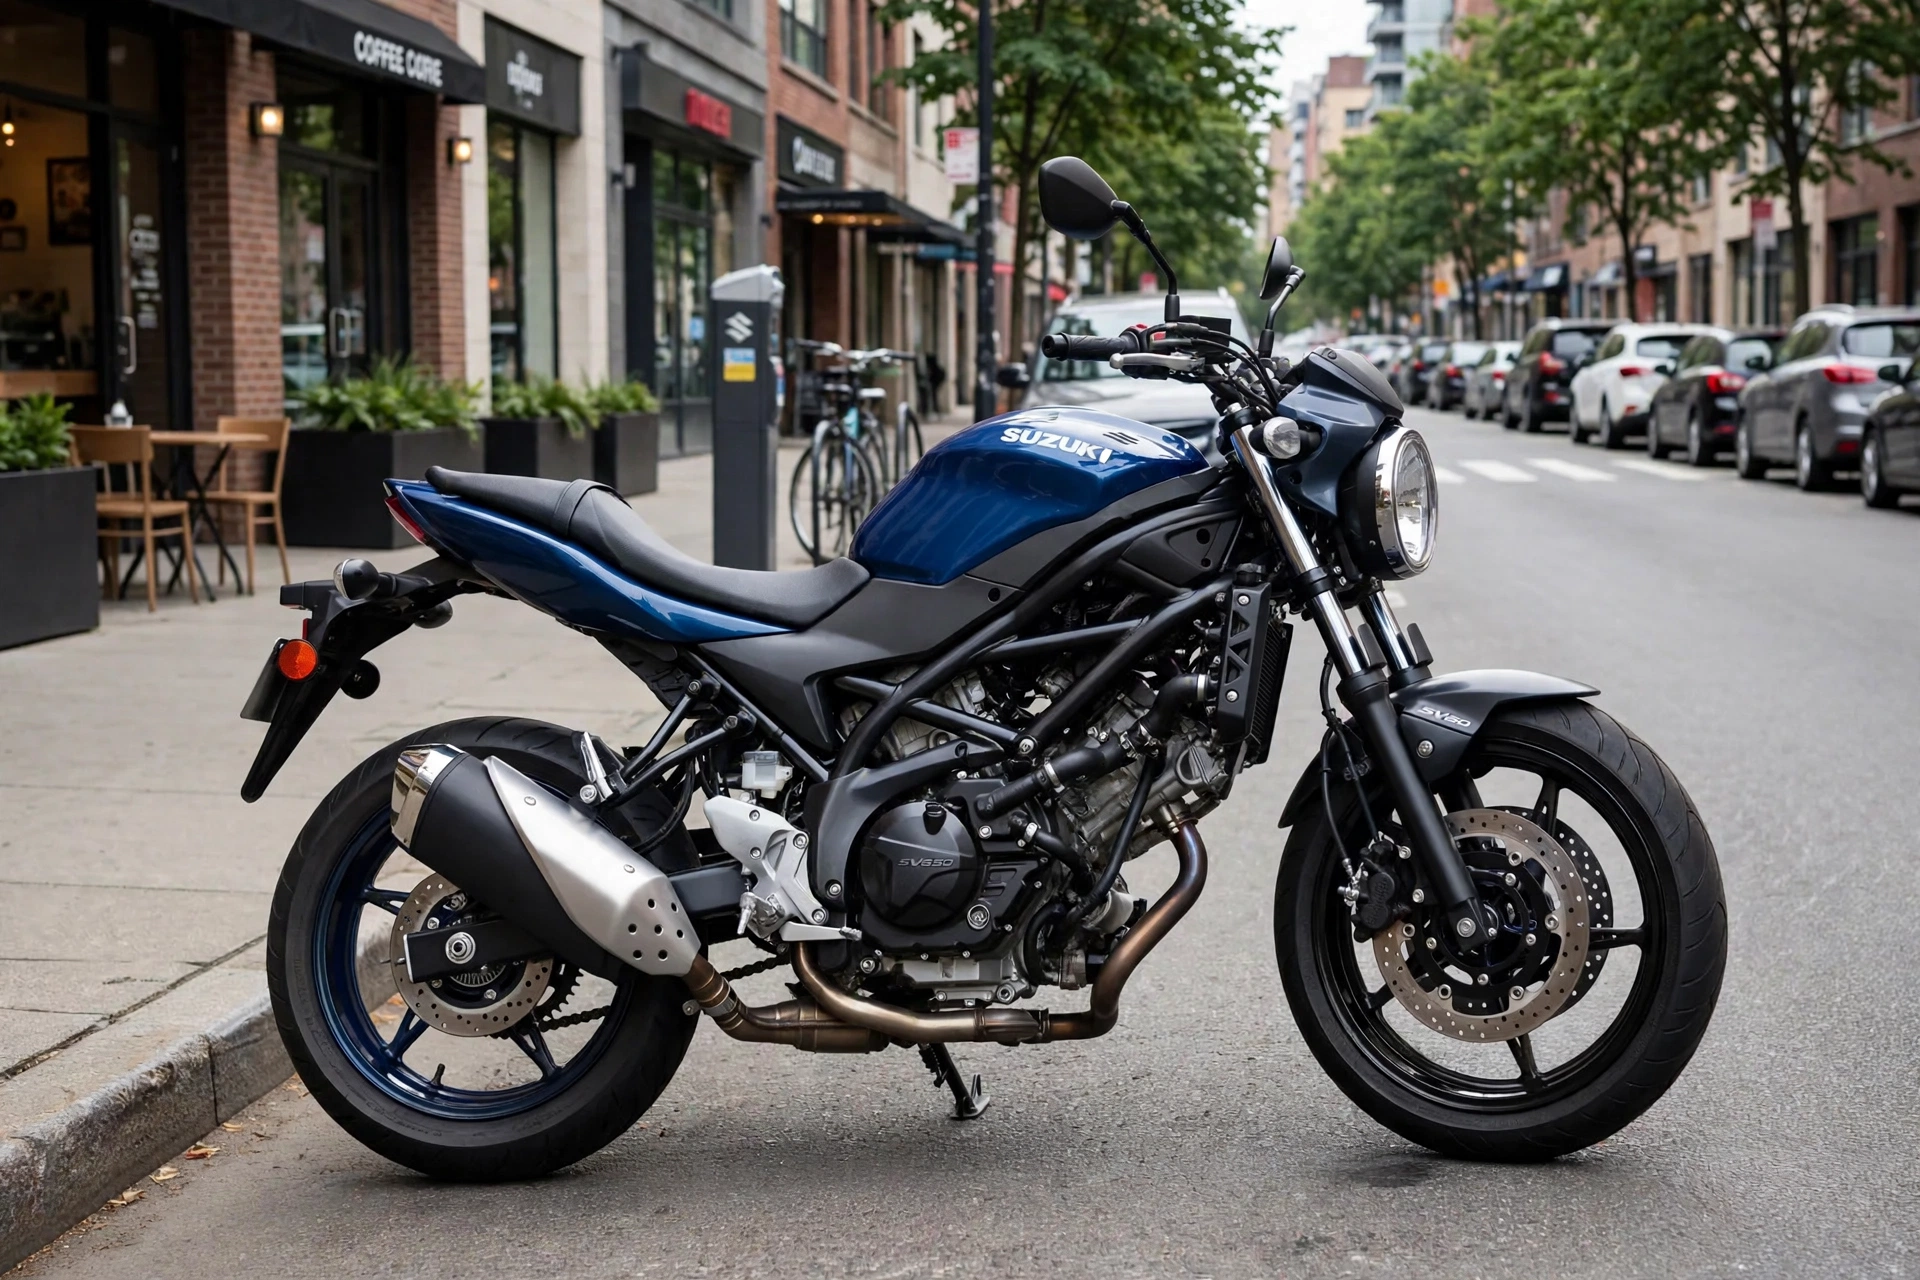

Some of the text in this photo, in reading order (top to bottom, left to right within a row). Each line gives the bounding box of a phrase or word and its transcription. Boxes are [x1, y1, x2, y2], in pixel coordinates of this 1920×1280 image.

[353, 31, 404, 75] COFFEE
[1000, 428, 1112, 464] SUZUKI
[898, 858, 954, 867] SV650
